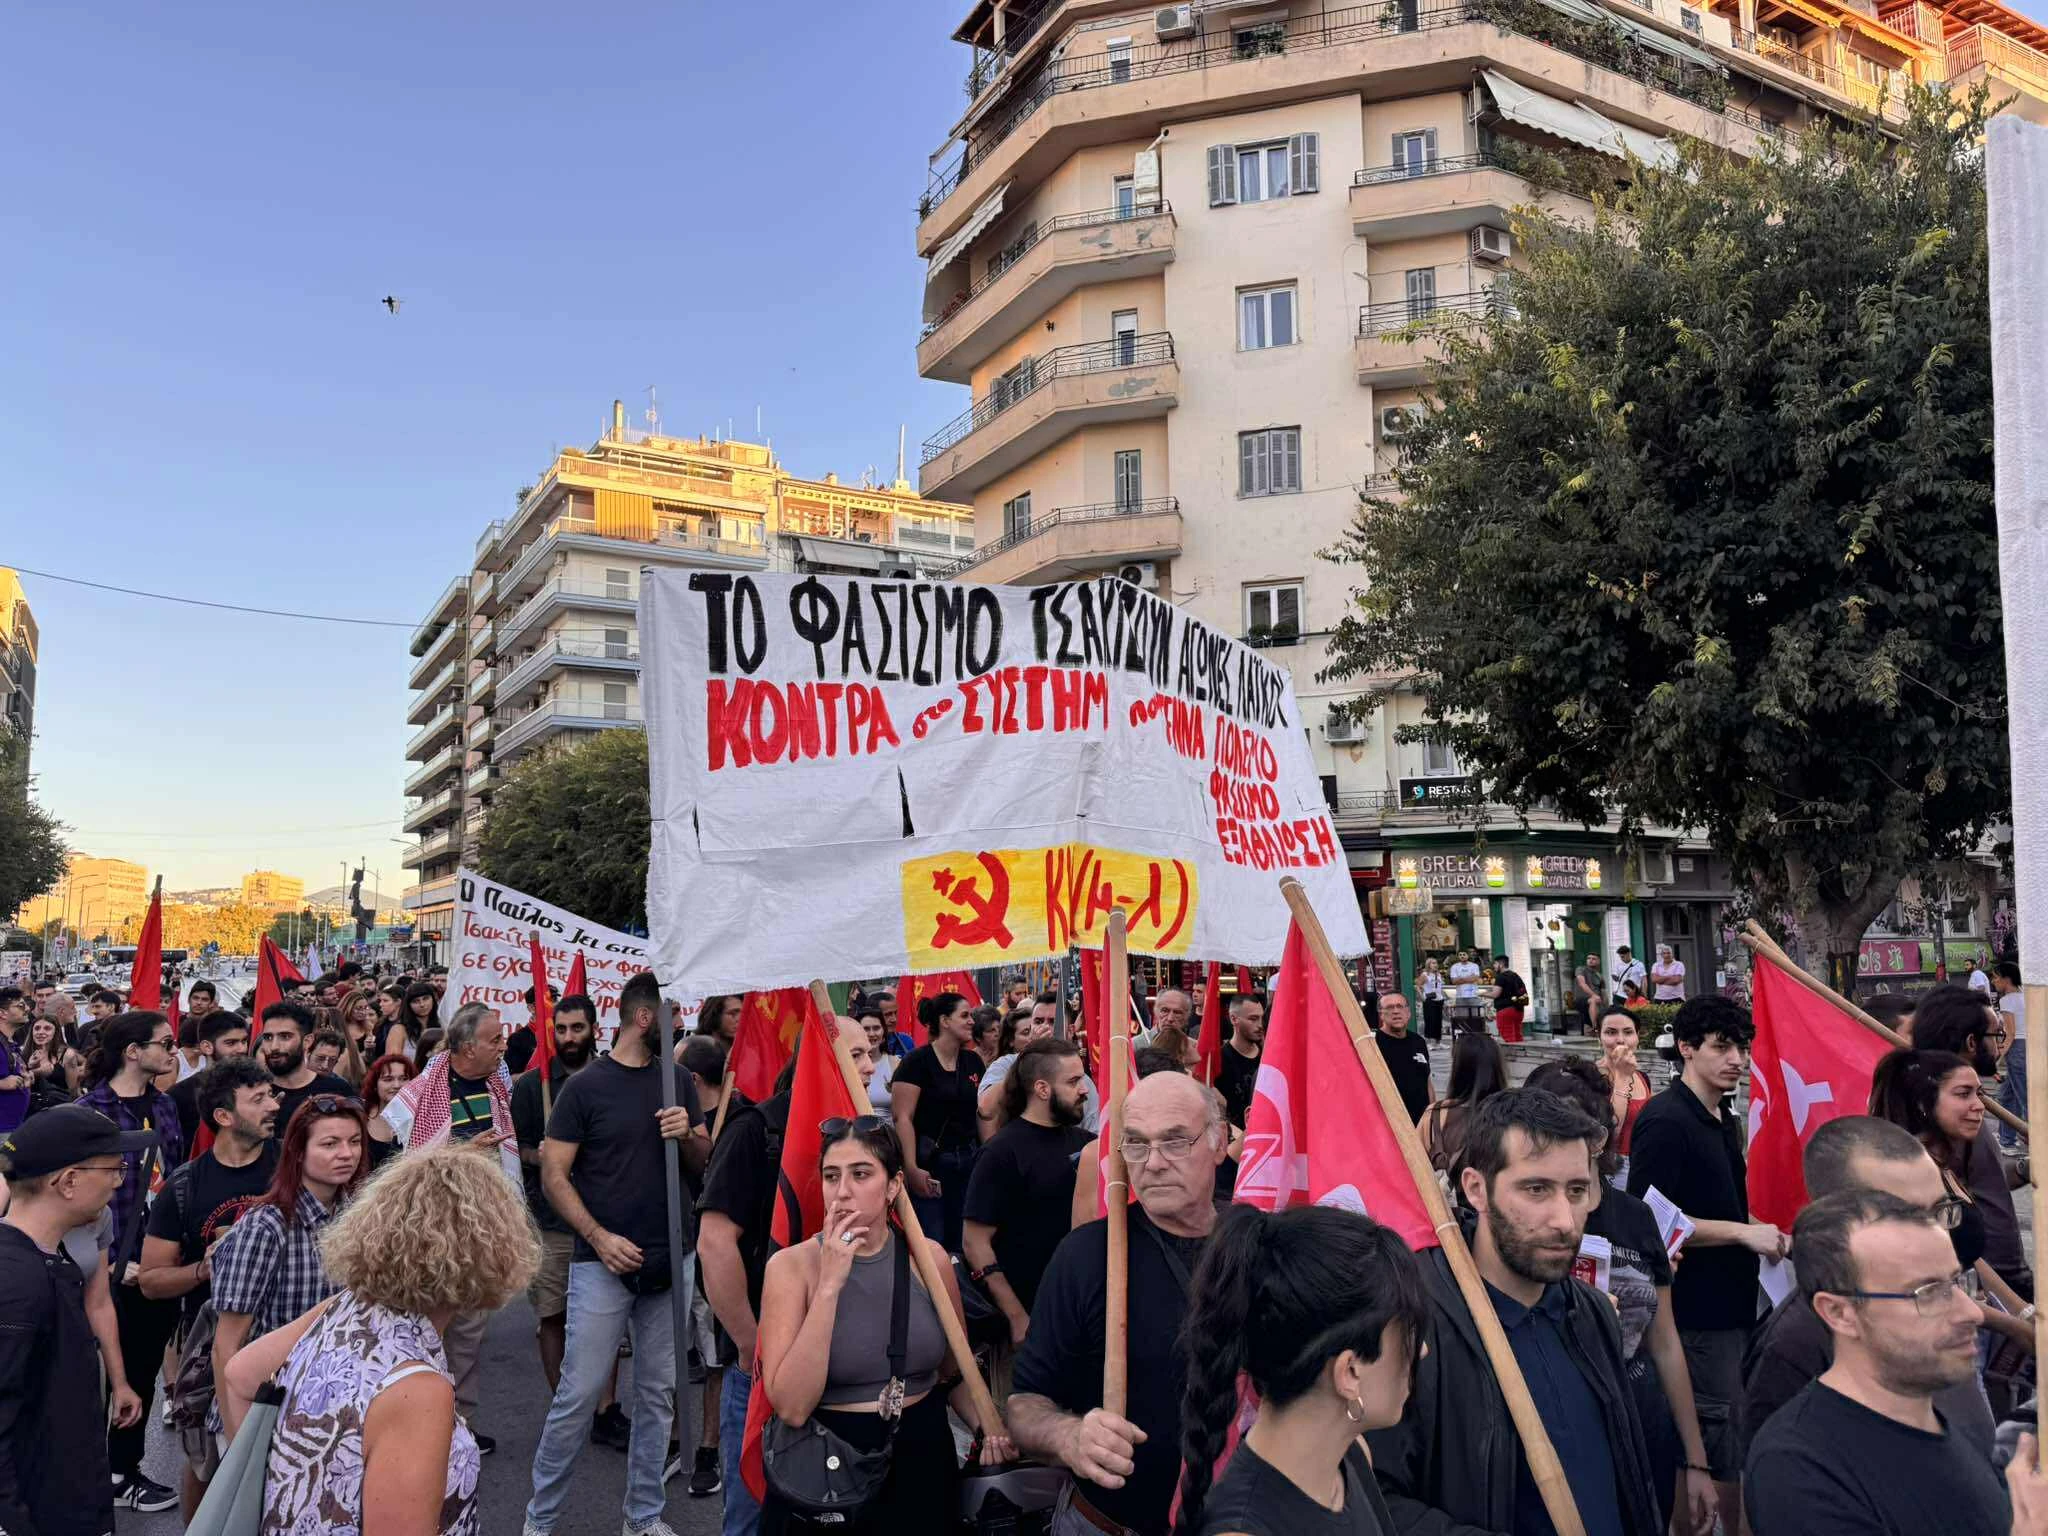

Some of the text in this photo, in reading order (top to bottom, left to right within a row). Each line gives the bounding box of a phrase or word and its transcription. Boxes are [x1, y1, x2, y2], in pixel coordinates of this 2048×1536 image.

[689, 573, 767, 673] ΤΟ
[789, 575, 1003, 686] ΦΑΣΙΣΜΟ
[706, 677, 901, 772] ΚΟΝΤΡΑ
[1421, 855, 1482, 872] GREEK
[1421, 875, 1482, 888] NATURAL
[484, 887, 566, 935] Παύλος
